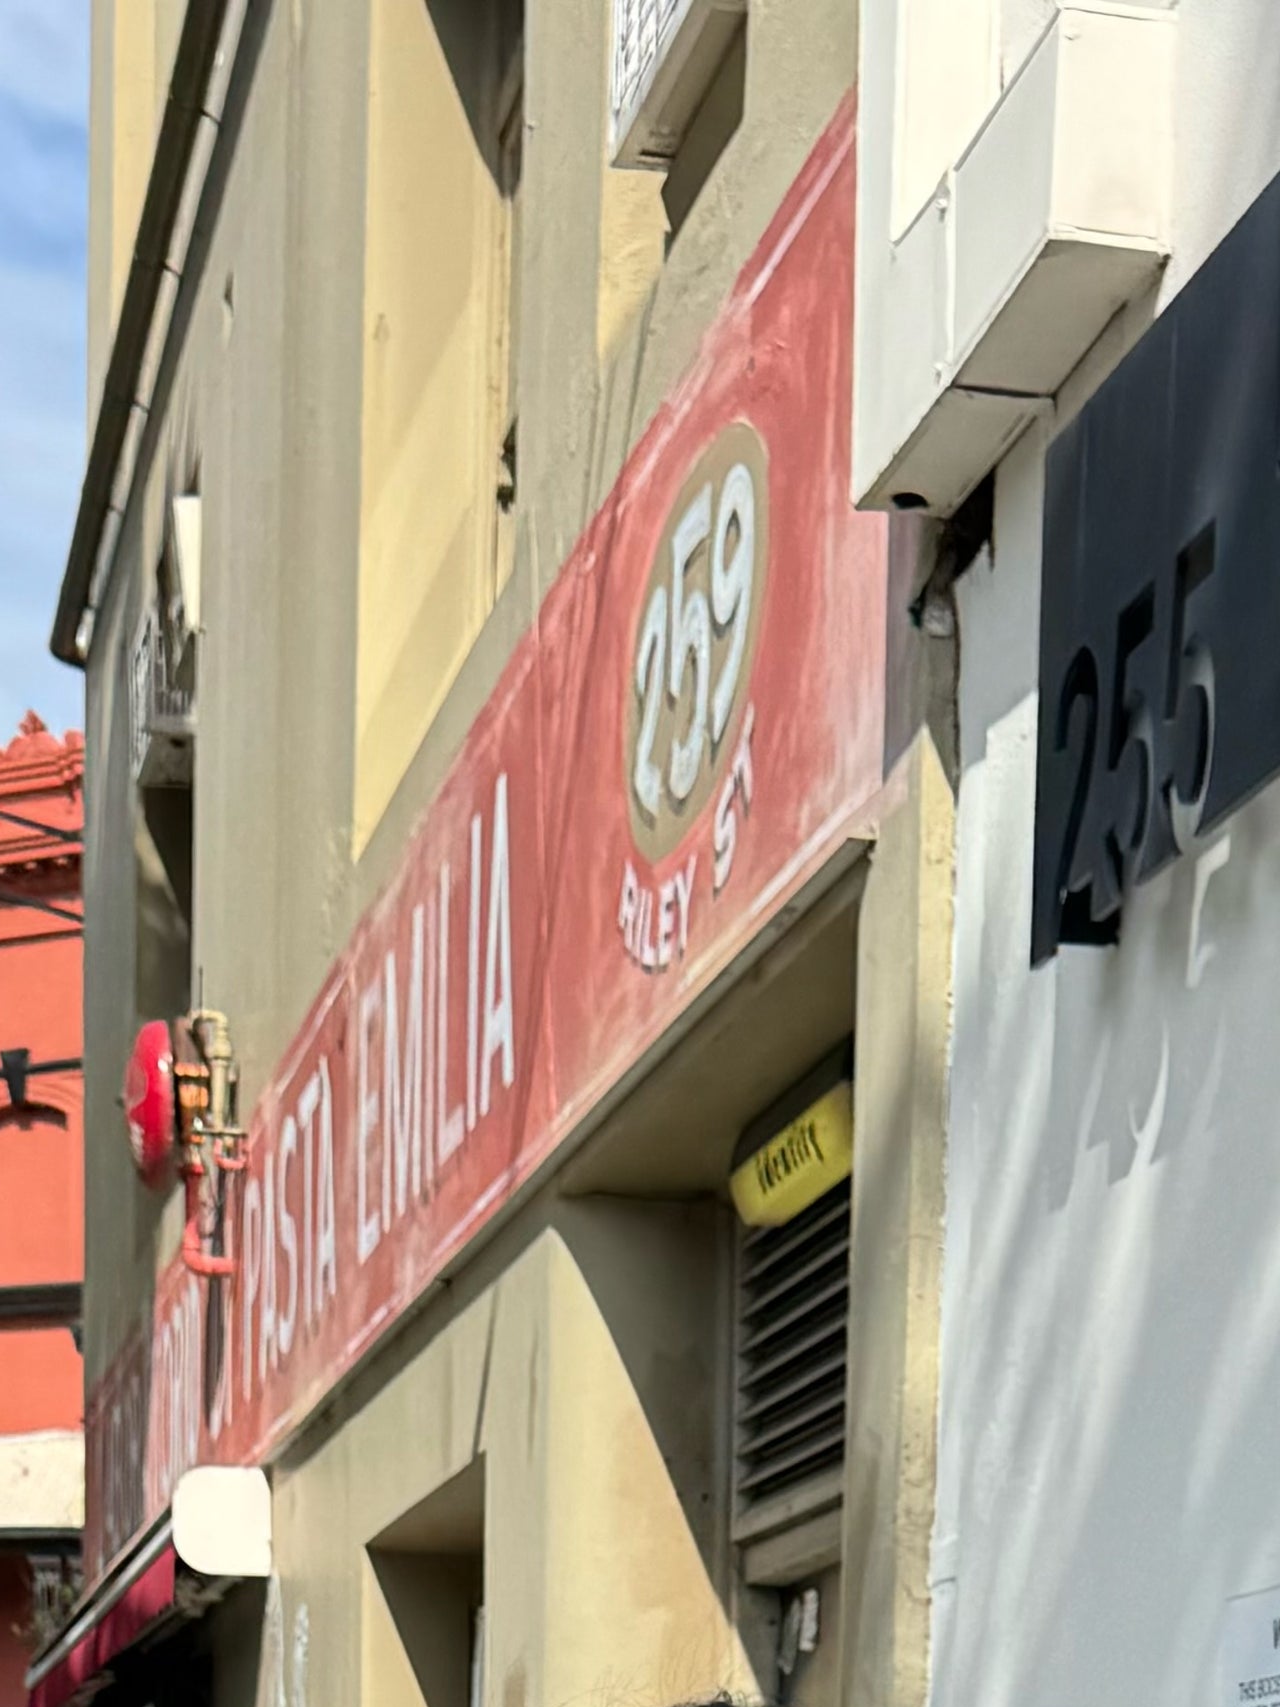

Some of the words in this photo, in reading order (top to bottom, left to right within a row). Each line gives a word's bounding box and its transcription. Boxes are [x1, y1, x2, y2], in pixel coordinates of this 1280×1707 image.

[634, 462, 755, 816] 259
[1053, 517, 1217, 945] 255
[620, 855, 697, 970] RILEY
[713, 702, 753, 896] ST
[241, 1055, 338, 1402] PASTA
[357, 772, 516, 1259] EMILIA
[1238, 1678, 1256, 1702] THIS
